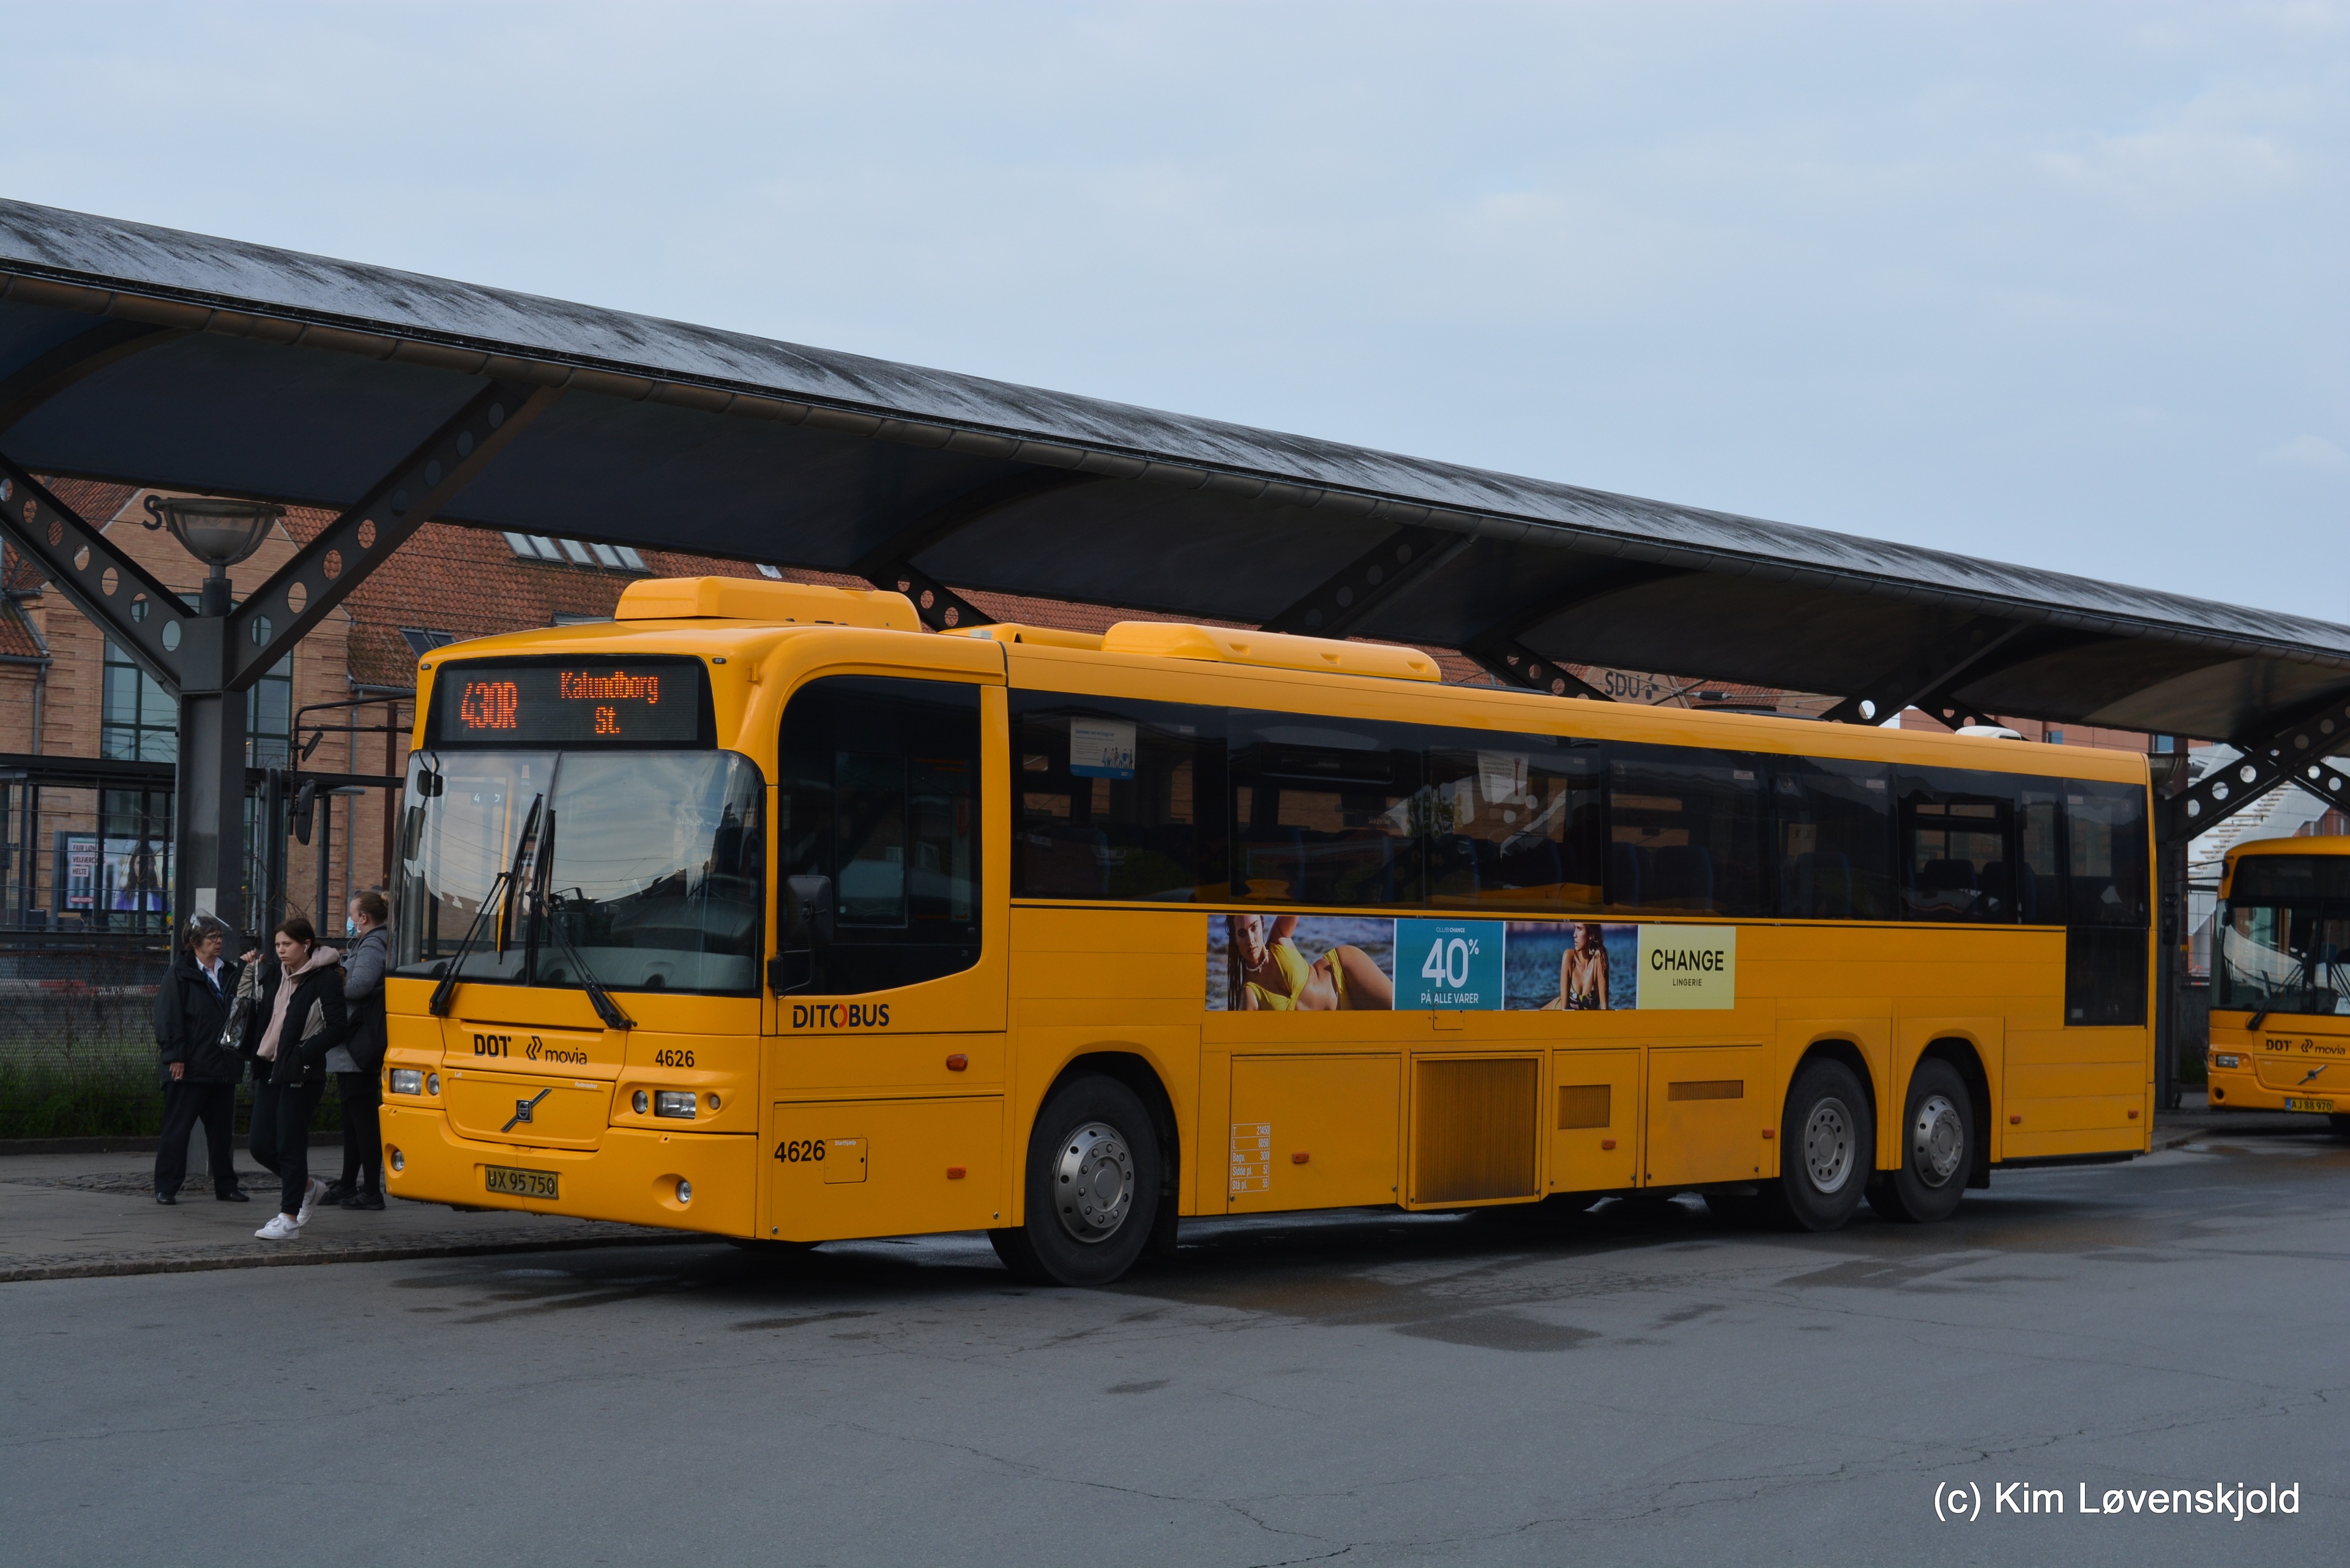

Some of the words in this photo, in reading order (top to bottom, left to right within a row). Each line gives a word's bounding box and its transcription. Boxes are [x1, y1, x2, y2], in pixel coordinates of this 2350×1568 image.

[1605, 671, 1640, 698] SDU
[461, 682, 517, 728] 430R
[561, 672, 659, 703] Kalundborg
[595, 707, 620, 733] St.
[1368, 816, 1391, 825] Slagelse
[1651, 949, 1724, 971] CHANGE
[1420, 989, 1431, 1004] PÅ
[1434, 993, 1452, 1004] ALLE
[1454, 993, 1479, 1004] VARER
[793, 1003, 889, 1029] DITOBUS
[473, 1034, 512, 1058] DOT
[2266, 1039, 2291, 1051] DOT
[2315, 1044, 2346, 1055] movia
[545, 1047, 588, 1066] movia
[655, 1049, 695, 1068] 4626
[2291, 1100, 2302, 1109] AJ
[2304, 1100, 2315, 1110] 88
[2316, 1101, 2332, 1111] 970
[1233, 1126, 1236, 1136] T
[1256, 1126, 1270, 1135] 21450
[774, 1140, 826, 1163] 4626
[1233, 1140, 1236, 1149] L
[1233, 1153, 1245, 1163] Bagv.
[1260, 1151, 1269, 1160] 300
[1233, 1166, 1245, 1176] Sidde
[1263, 1165, 1268, 1174] 52
[488, 1170, 506, 1189] UX
[510, 1173, 526, 1191] 95
[529, 1176, 555, 1195] 750
[1232, 1180, 1240, 1190] Stå
